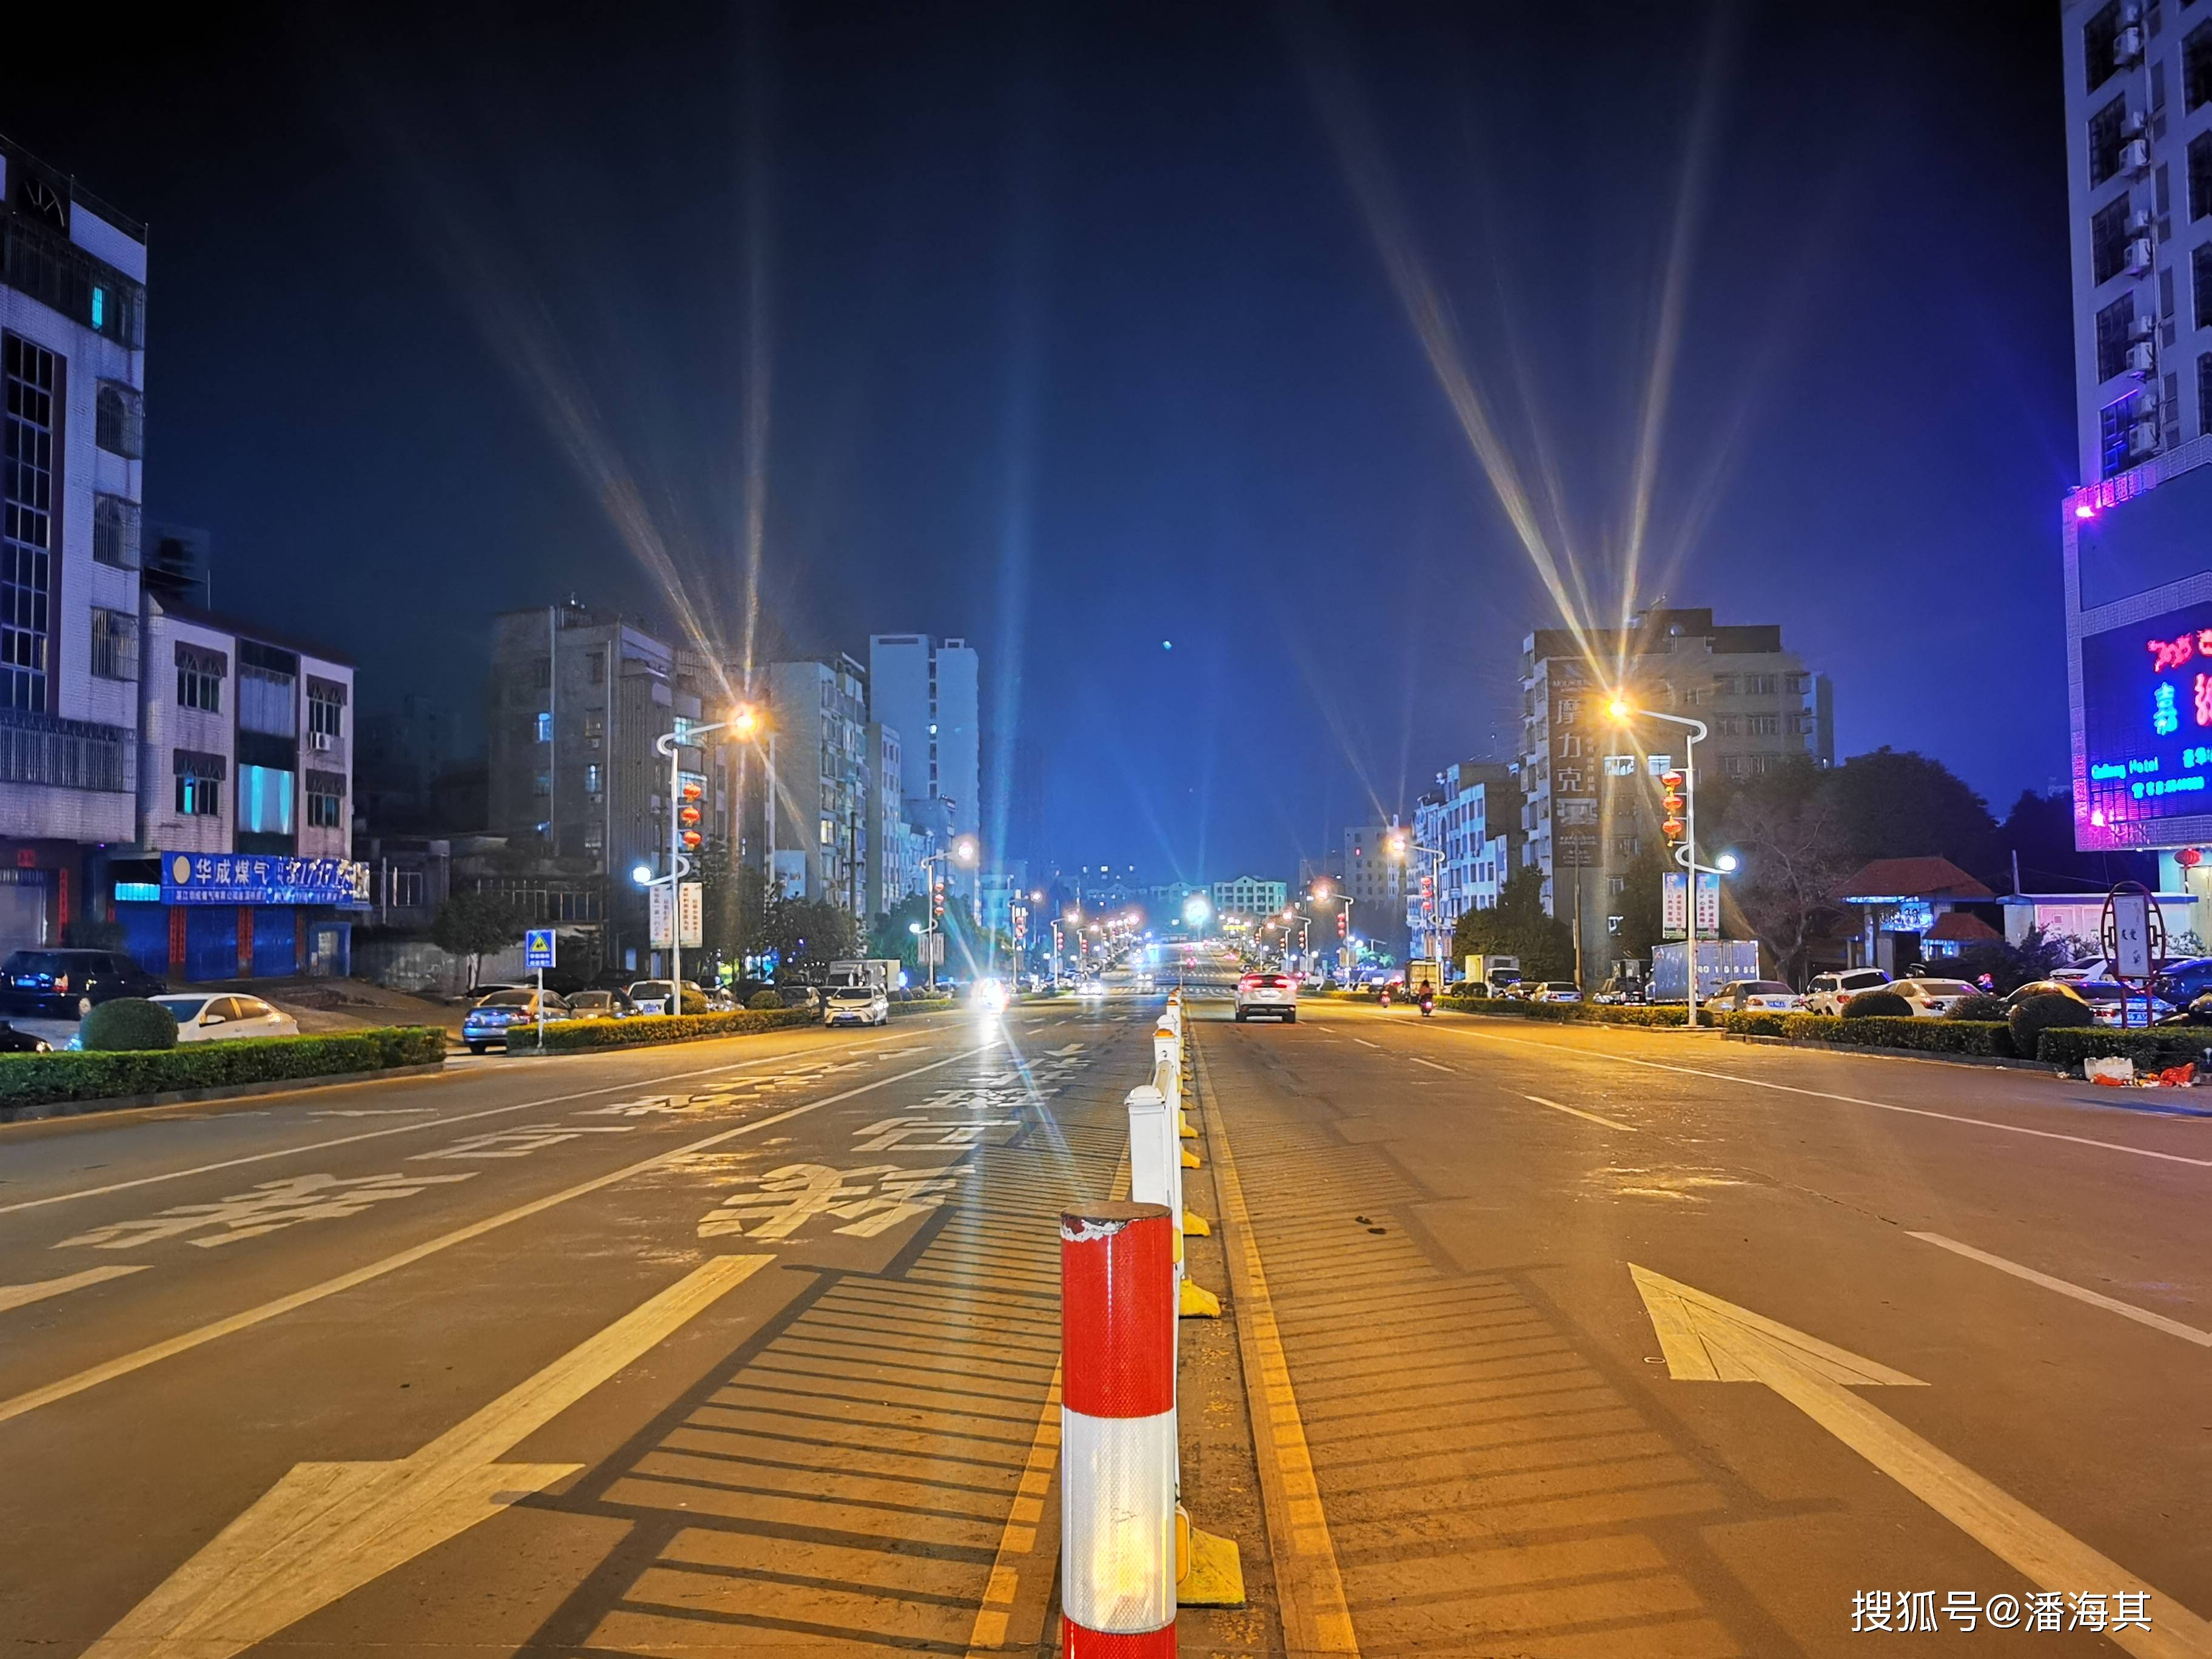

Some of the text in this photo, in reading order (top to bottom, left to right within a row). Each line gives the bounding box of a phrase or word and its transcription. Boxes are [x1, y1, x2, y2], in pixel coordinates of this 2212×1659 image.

[1556, 699, 1584, 792] 摩力克
[2129, 756, 2159, 774] Hotel
[196, 858, 270, 886] 华成煤气
